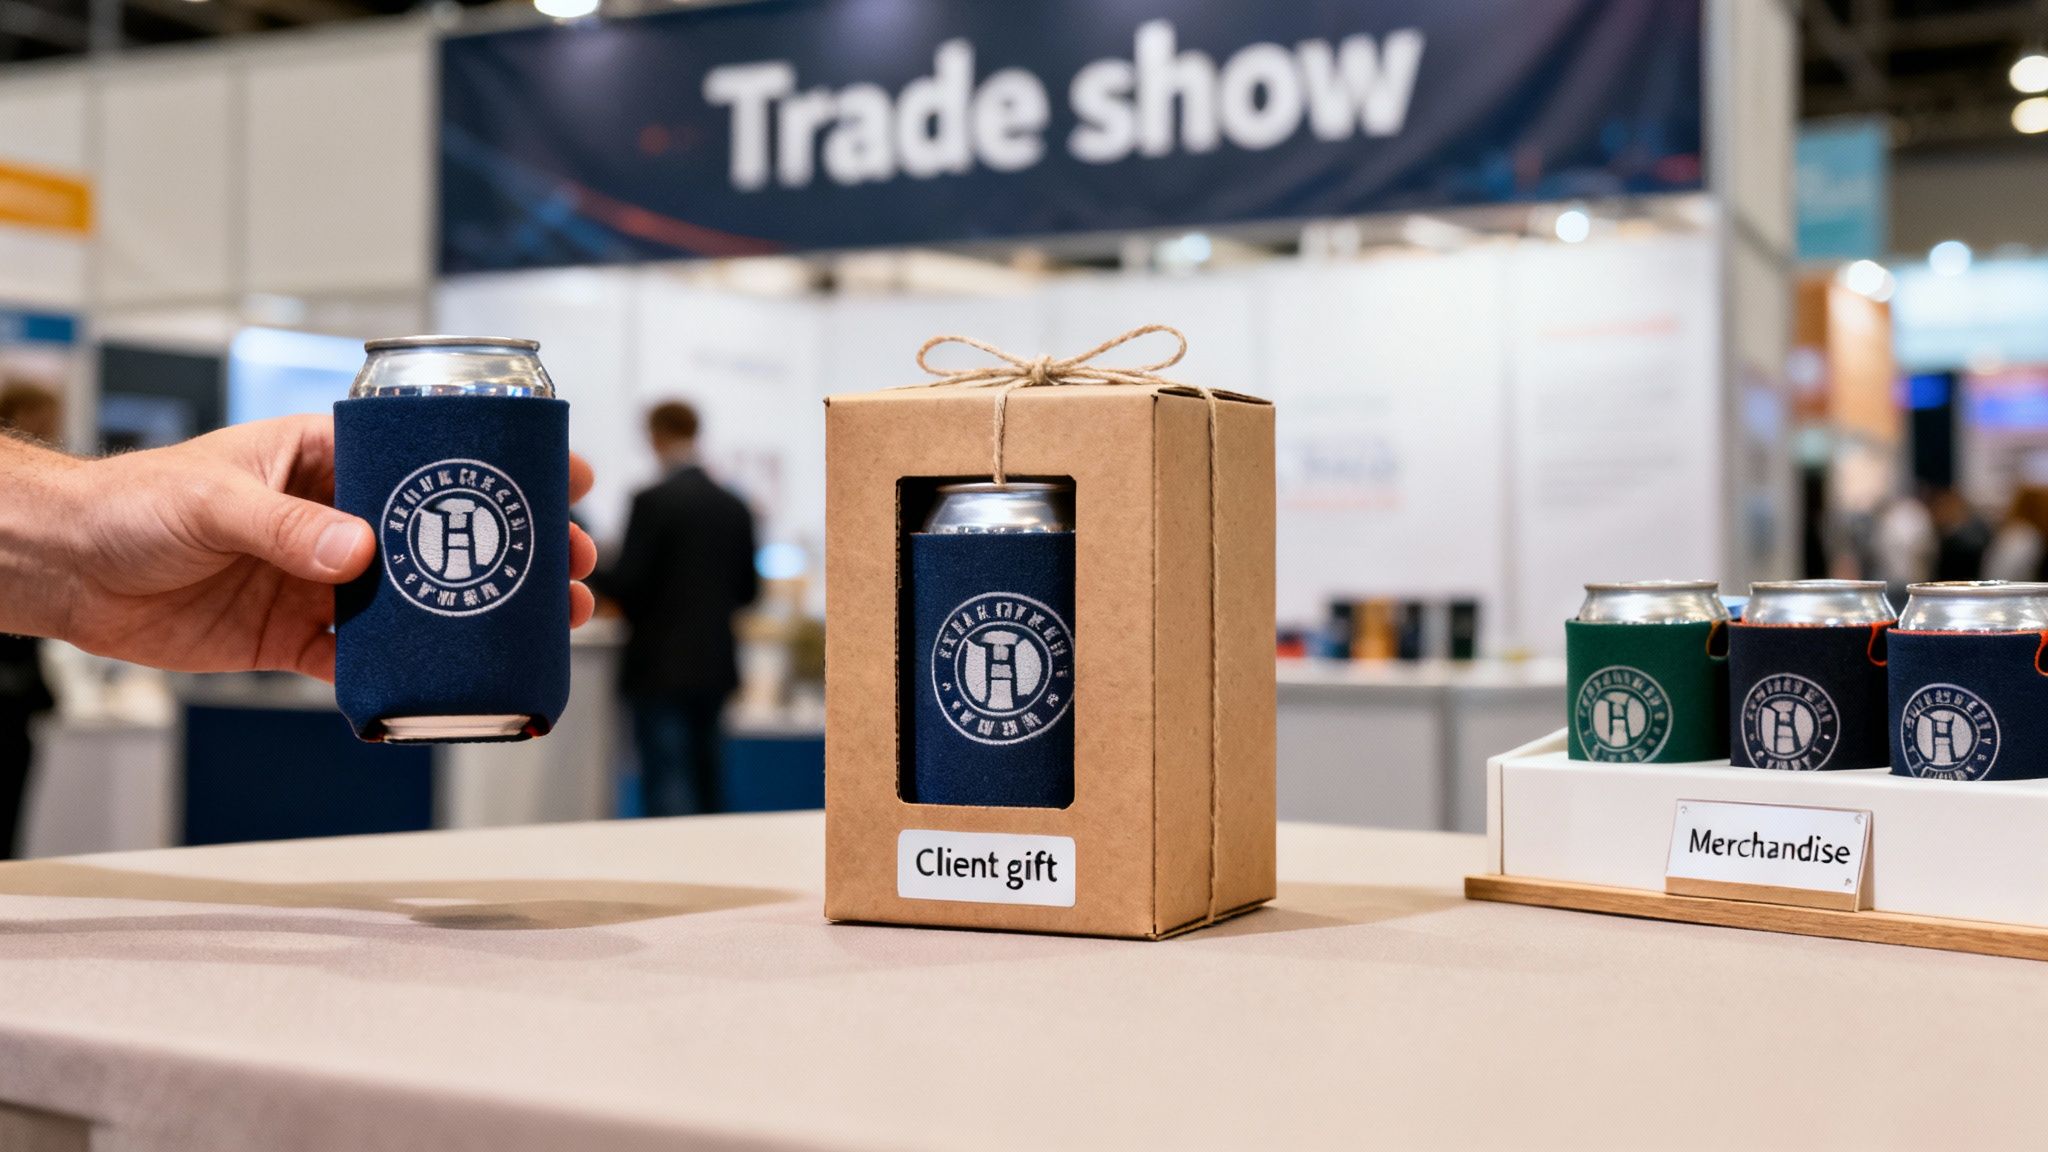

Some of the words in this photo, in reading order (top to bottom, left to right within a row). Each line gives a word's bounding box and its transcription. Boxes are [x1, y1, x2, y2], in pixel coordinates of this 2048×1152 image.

[702, 38, 1049, 192] Trade
[1068, 19, 1424, 163] show
[1689, 828, 1851, 864] Merchandise
[915, 847, 999, 878] Client
[1006, 850, 1058, 891] gift
